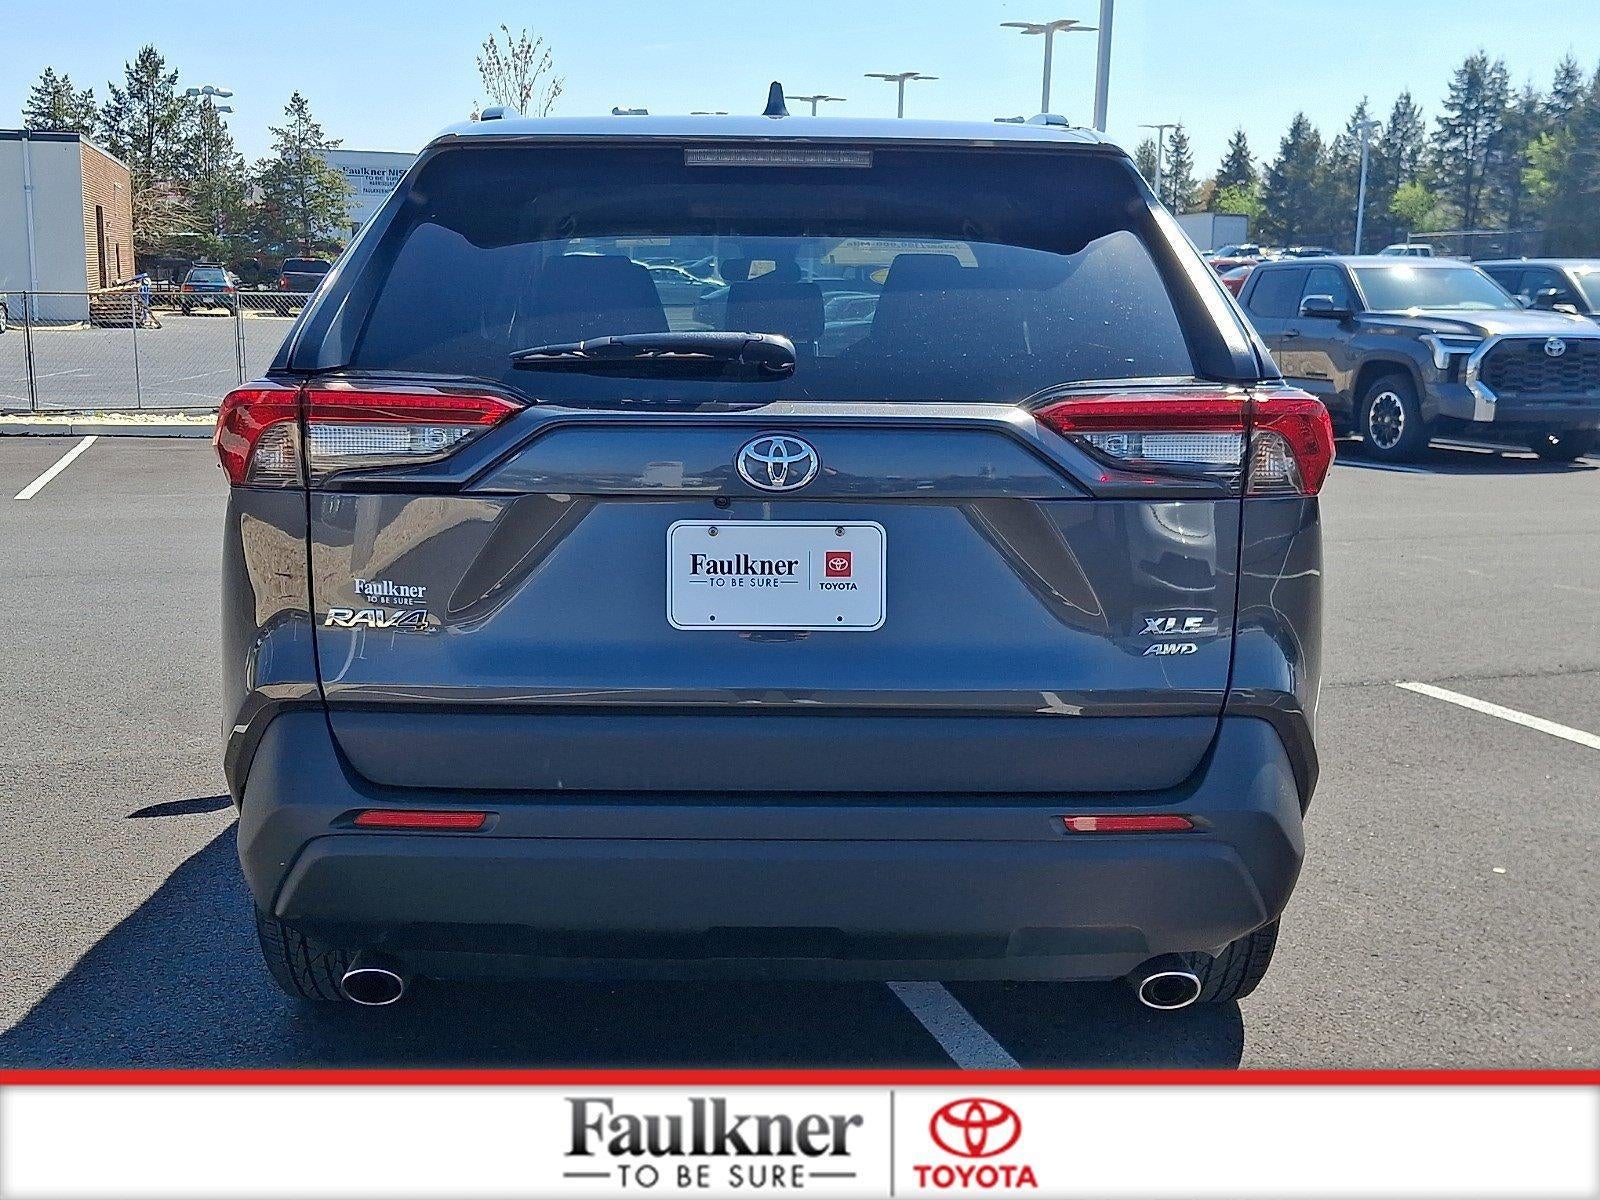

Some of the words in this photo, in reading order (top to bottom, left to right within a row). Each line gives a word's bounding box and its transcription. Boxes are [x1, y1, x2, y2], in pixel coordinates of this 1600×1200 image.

[388, 169, 406, 177] NIS
[689, 554, 799, 576] Faulkner
[354, 579, 427, 598] Faulkner
[709, 578, 726, 587] TO
[731, 578, 744, 587] BE
[750, 578, 779, 588] SURE
[819, 582, 858, 591] TOYOTA
[394, 597, 414, 605] SURE
[325, 608, 429, 630] RAV4
[1139, 617, 1204, 635] XLE
[1142, 643, 1198, 656] AWD
